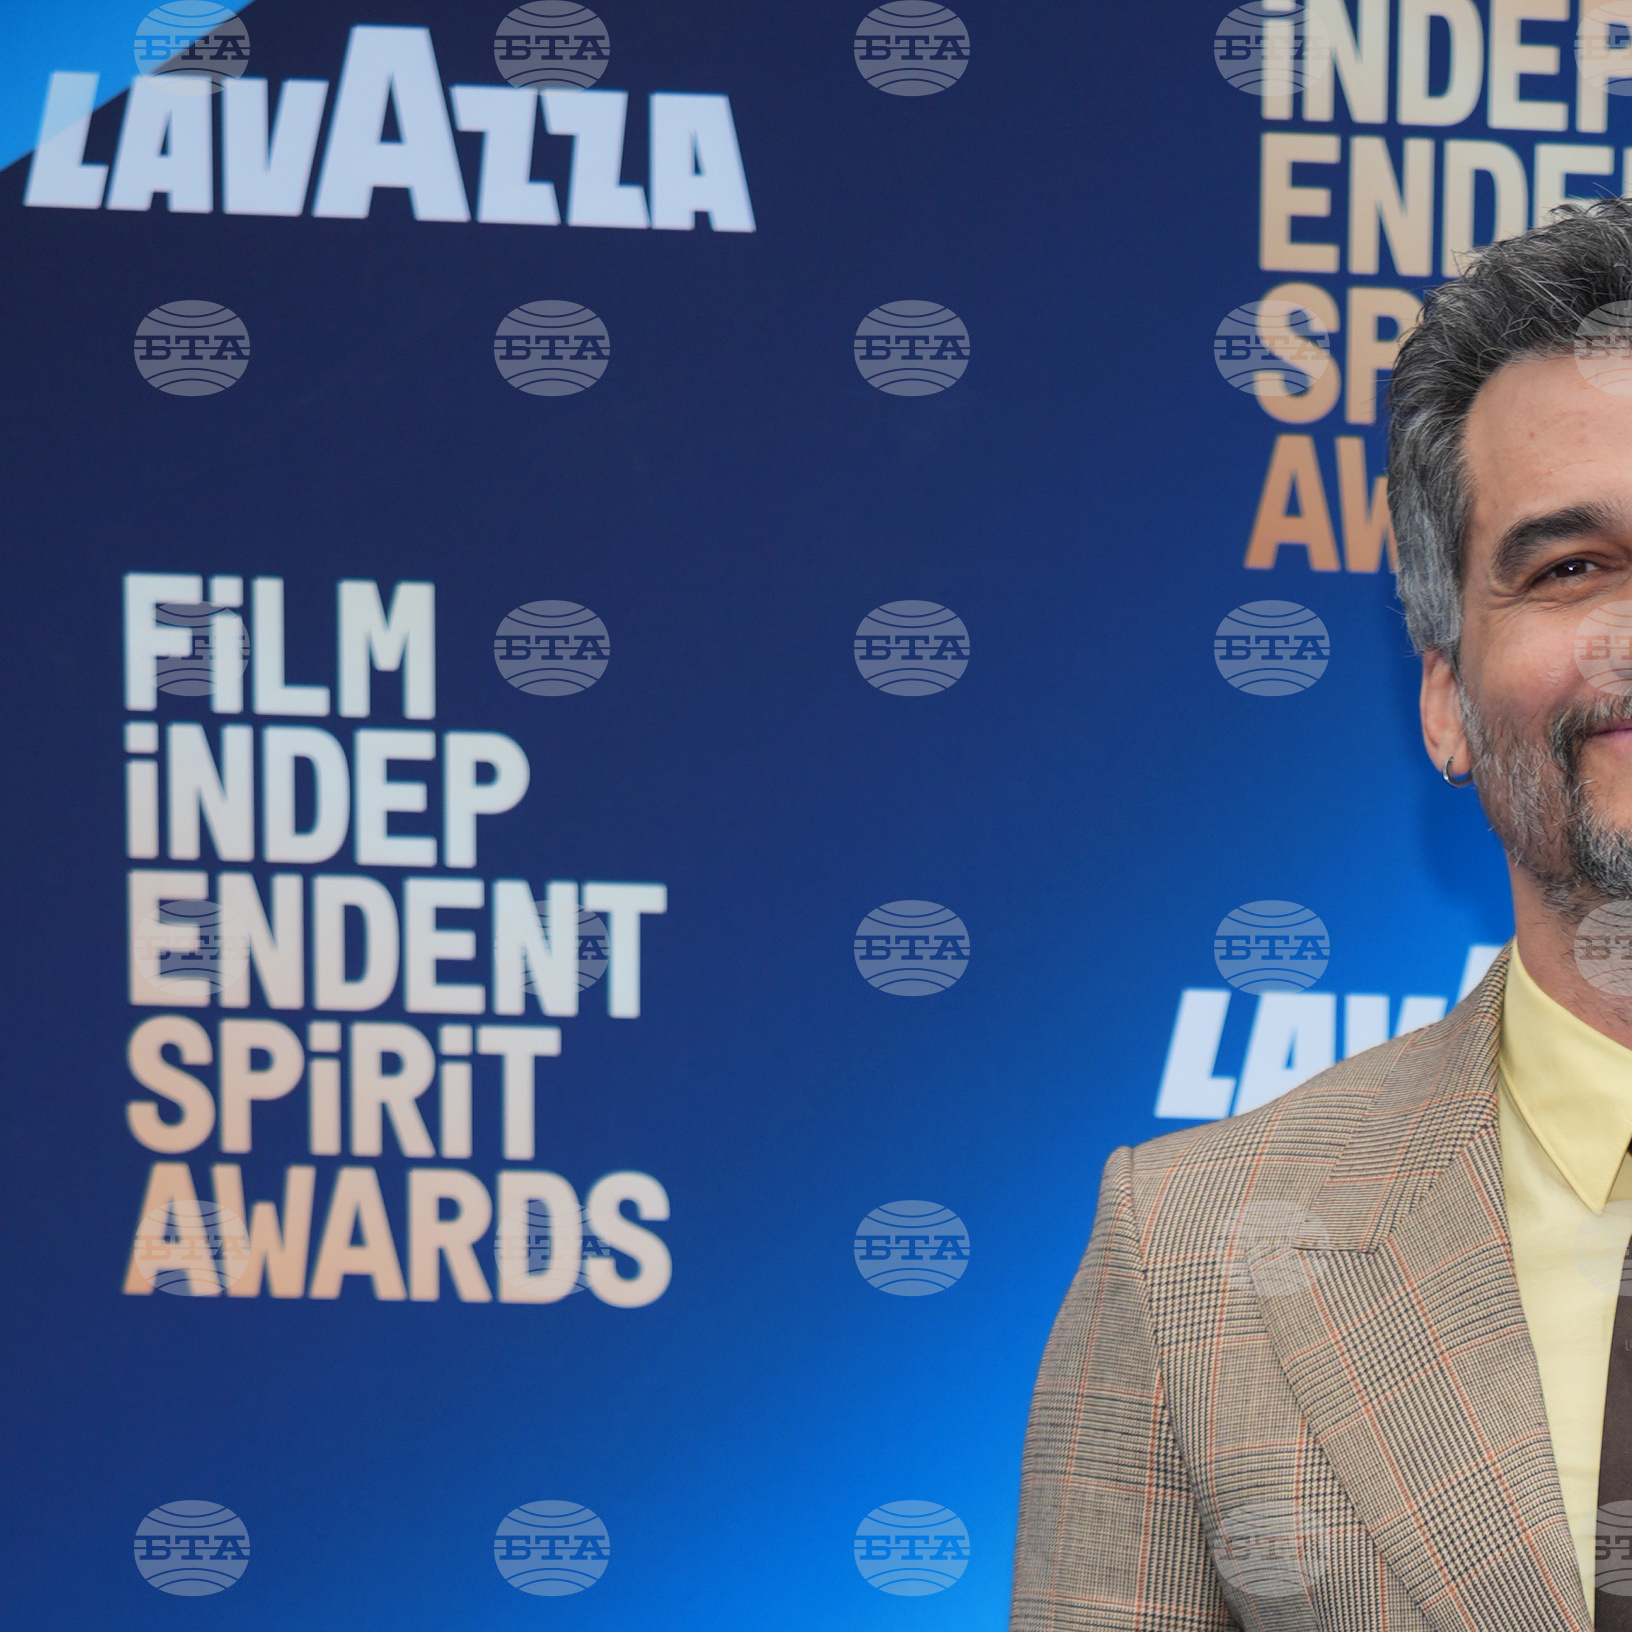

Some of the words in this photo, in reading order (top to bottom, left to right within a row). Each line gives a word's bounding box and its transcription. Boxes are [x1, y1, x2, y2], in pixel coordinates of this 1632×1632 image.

[23, 26, 754, 233] LAVAZZA
[125, 574, 435, 720] FiLM
[126, 722, 530, 869] iNDEP
[129, 870, 667, 1019] ENDENT
[127, 1015, 561, 1161] SPiRiT
[124, 1162, 672, 1308] AWARDS
